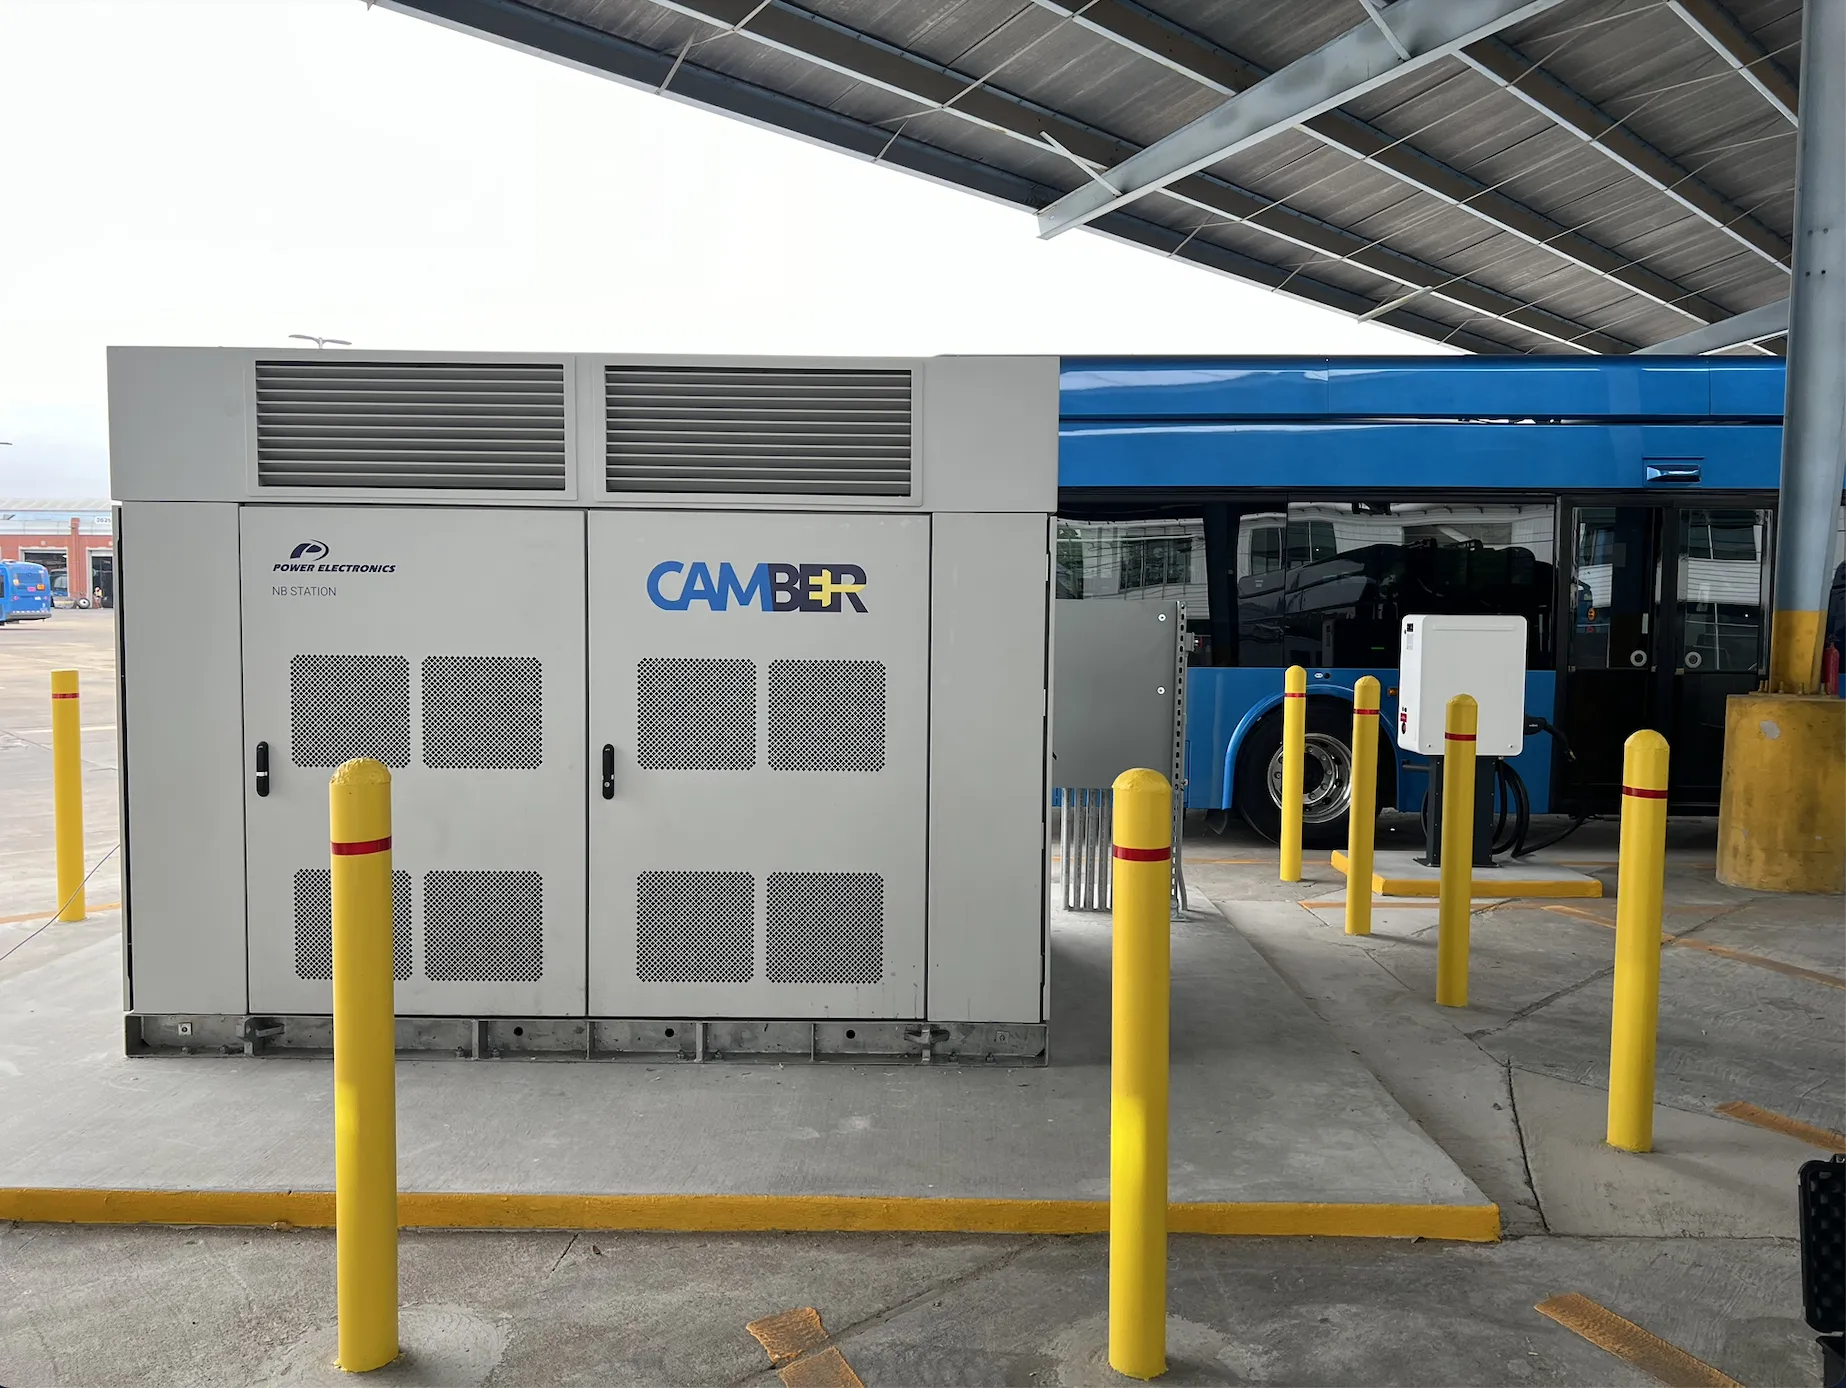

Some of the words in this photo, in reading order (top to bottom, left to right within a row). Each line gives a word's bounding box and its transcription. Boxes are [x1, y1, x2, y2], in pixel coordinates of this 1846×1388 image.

[272, 563, 316, 572] POWER
[317, 564, 396, 573] ELECTRONICS
[272, 586, 288, 596] NB
[290, 586, 337, 597] STATION
[646, 560, 869, 613] CAMBER
